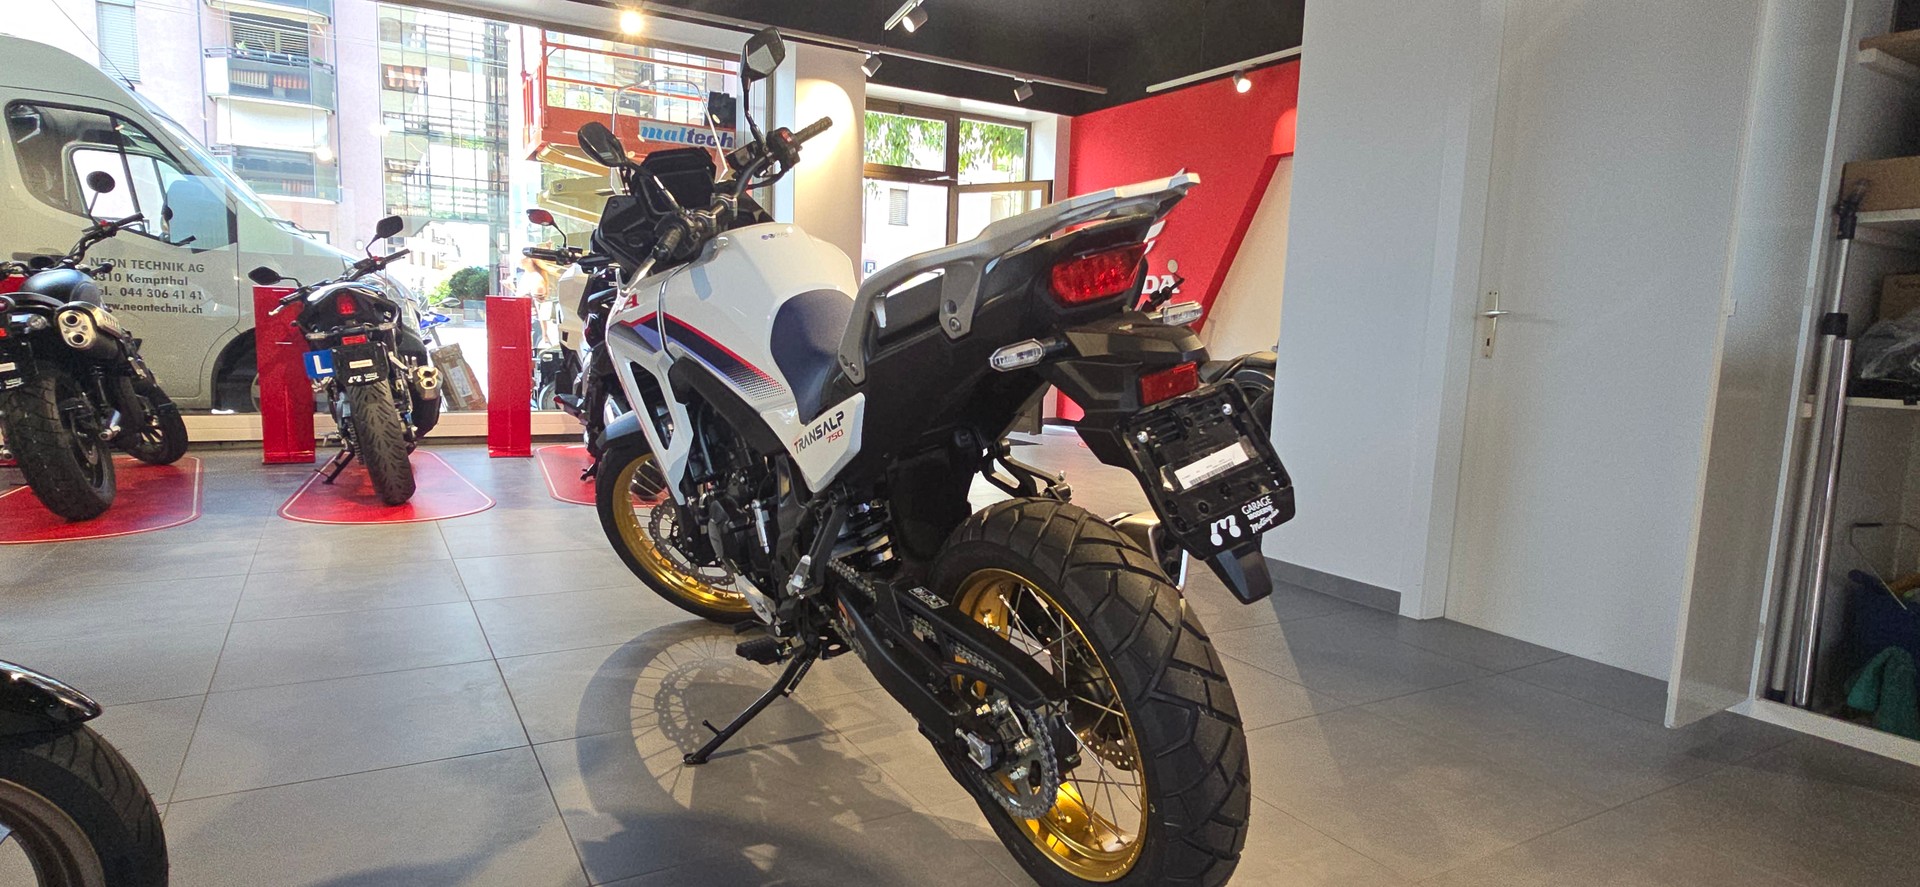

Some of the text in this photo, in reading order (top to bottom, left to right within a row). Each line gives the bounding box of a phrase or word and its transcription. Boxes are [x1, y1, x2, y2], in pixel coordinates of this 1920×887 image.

[641, 126, 733, 148] maltech
[90, 257, 205, 273] NEON TECHNIK AG
[126, 274, 188, 286] Kemptthal
[120, 287, 142, 297] 044
[147, 289, 169, 298] 306
[172, 290, 185, 299] 41
[313, 355, 333, 374] L
[794, 410, 845, 454] TRANSALP
[826, 428, 844, 443] 750
[1241, 495, 1273, 515] GARAGE
